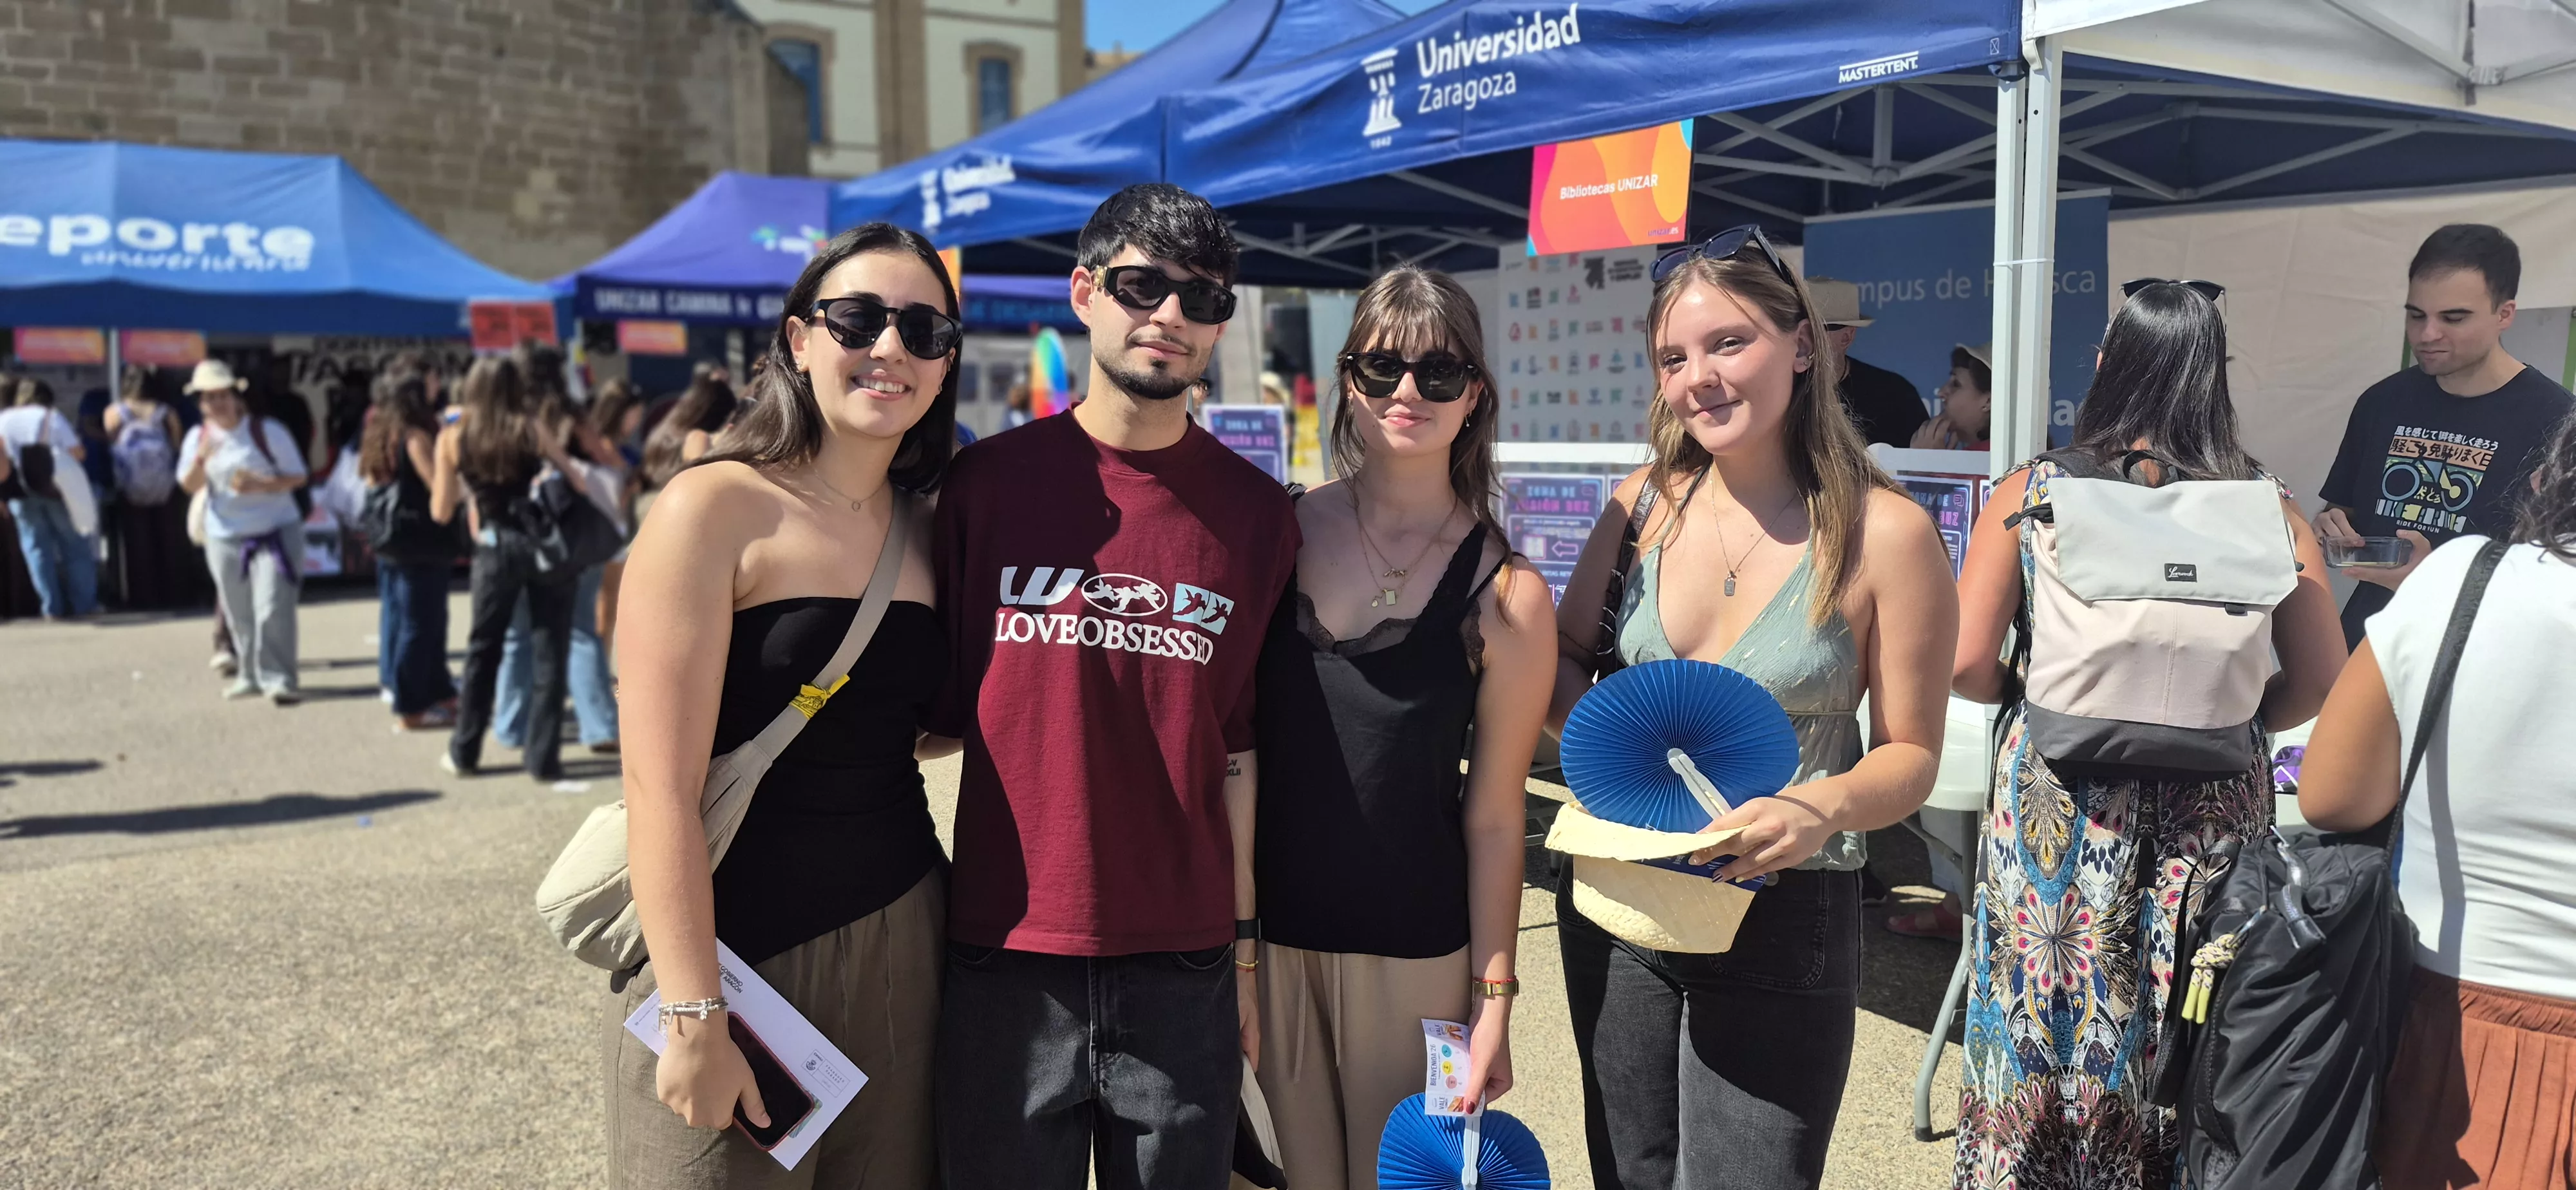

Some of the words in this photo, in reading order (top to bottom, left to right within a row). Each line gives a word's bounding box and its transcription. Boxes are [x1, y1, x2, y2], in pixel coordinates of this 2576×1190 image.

[1417, 2, 1581, 78] Universidad
[1418, 71, 1516, 114] Zaragoza
[1560, 182, 1615, 200] Bibliotecas
[1618, 174, 1658, 191] UNIZAR
[1648, 227, 1679, 236] unizar.es
[1858, 277, 1926, 309] mpus
[1936, 269, 1972, 299] de
[1527, 486, 1556, 498] ZONA
[1562, 487, 1576, 498] DE
[1566, 500, 1591, 513] BUZ
[1937, 494, 1949, 507] DE
[1939, 511, 1959, 526] BUZ
[2413, 522, 2427, 531] FOR
[721, 966, 743, 987] GOBIERNO
